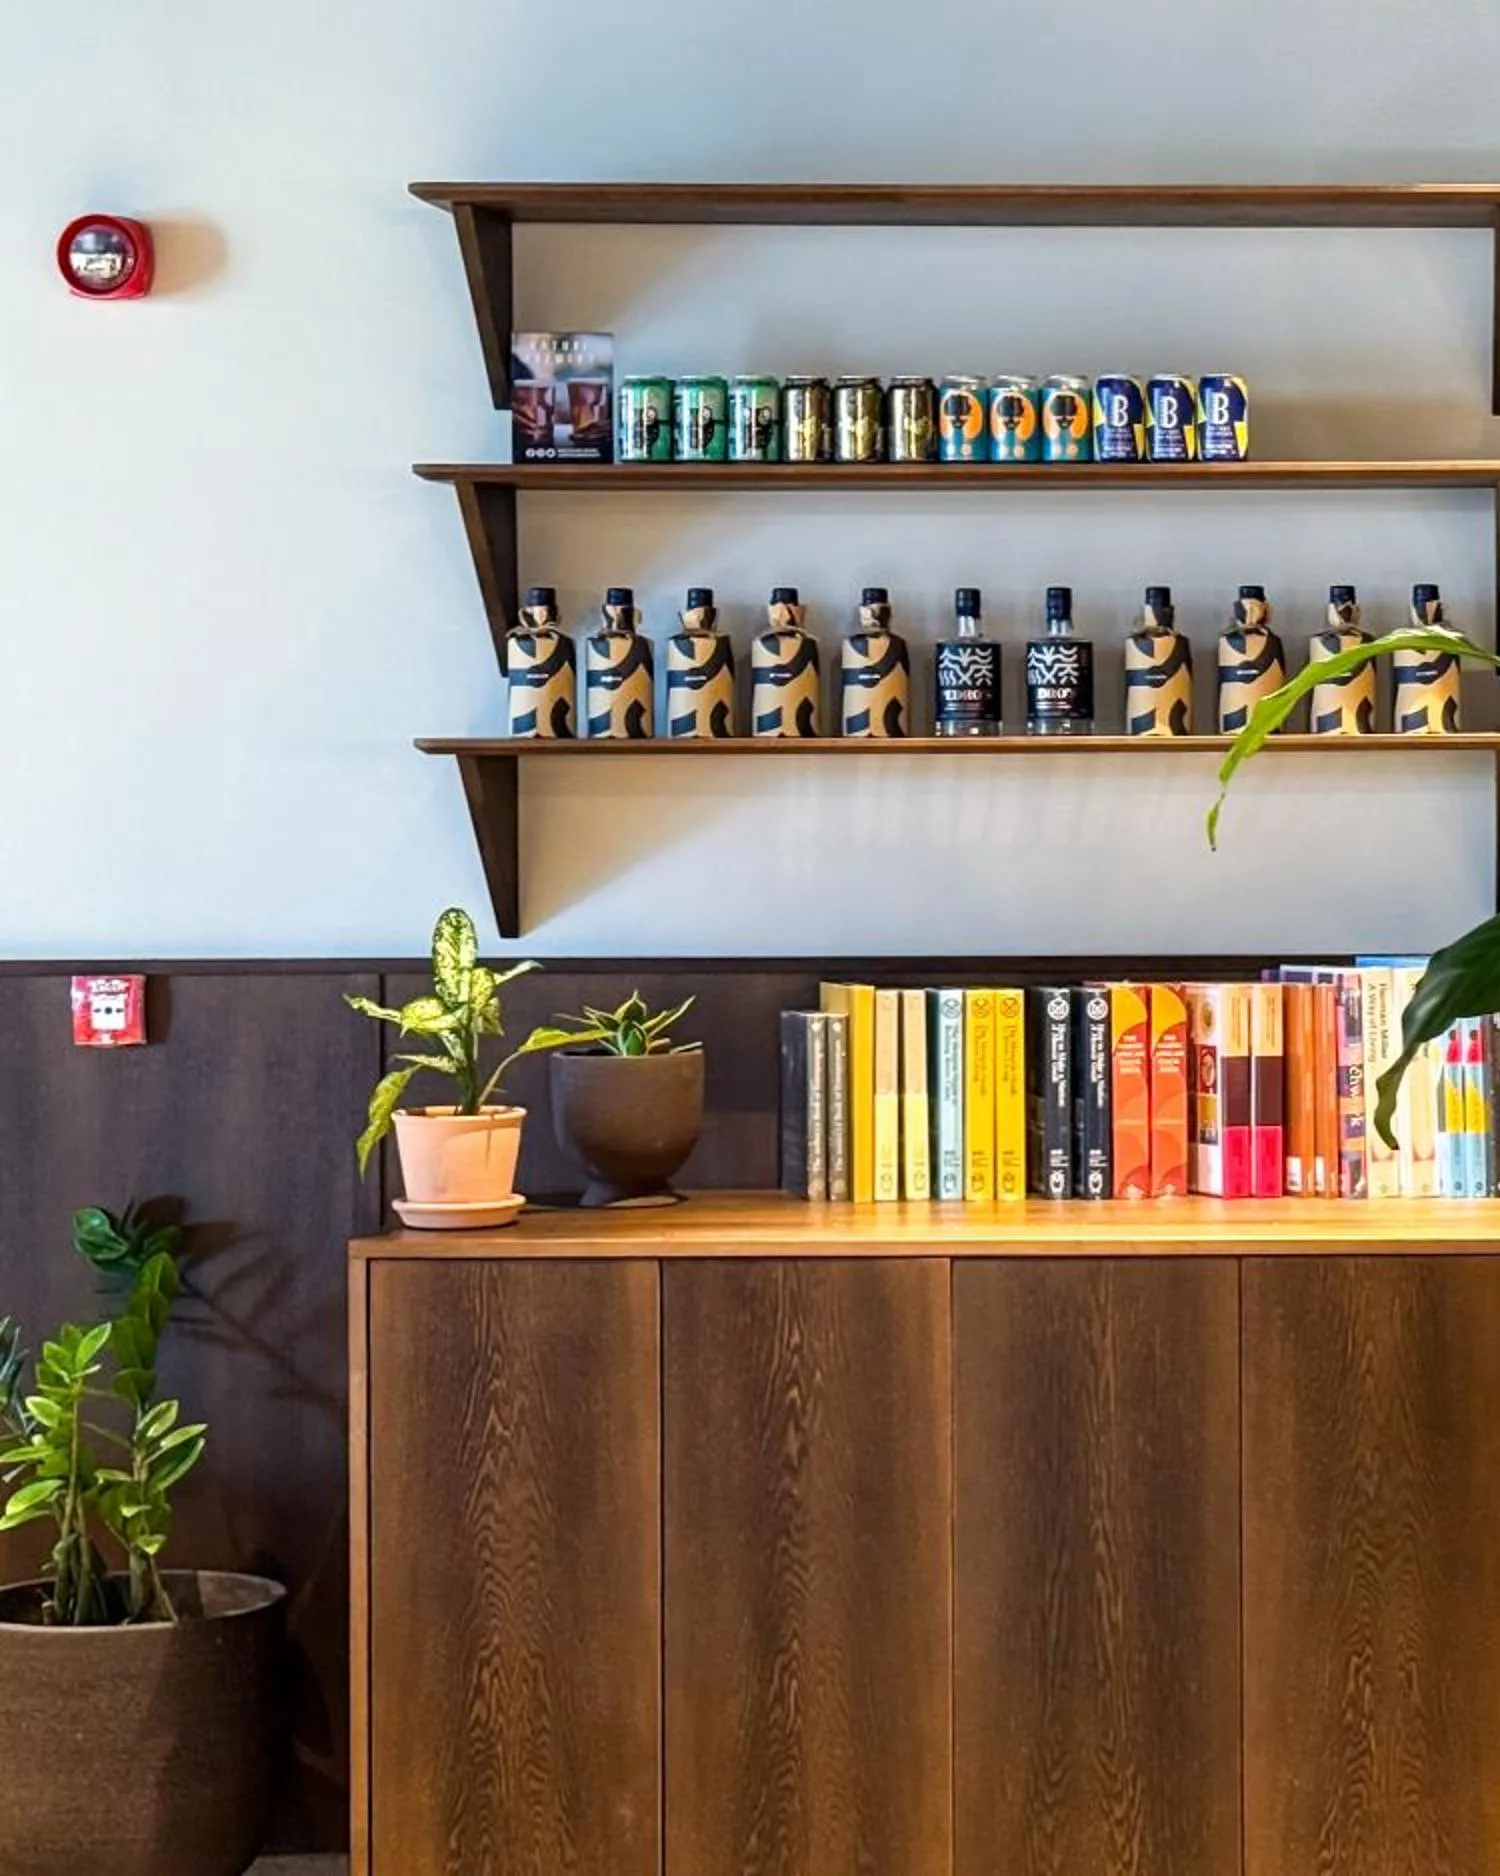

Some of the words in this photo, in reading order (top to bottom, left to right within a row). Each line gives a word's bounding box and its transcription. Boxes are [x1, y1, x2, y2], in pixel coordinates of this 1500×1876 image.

[1112, 394, 1129, 427] B
[1160, 395, 1178, 428] B
[1212, 392, 1230, 425] B
